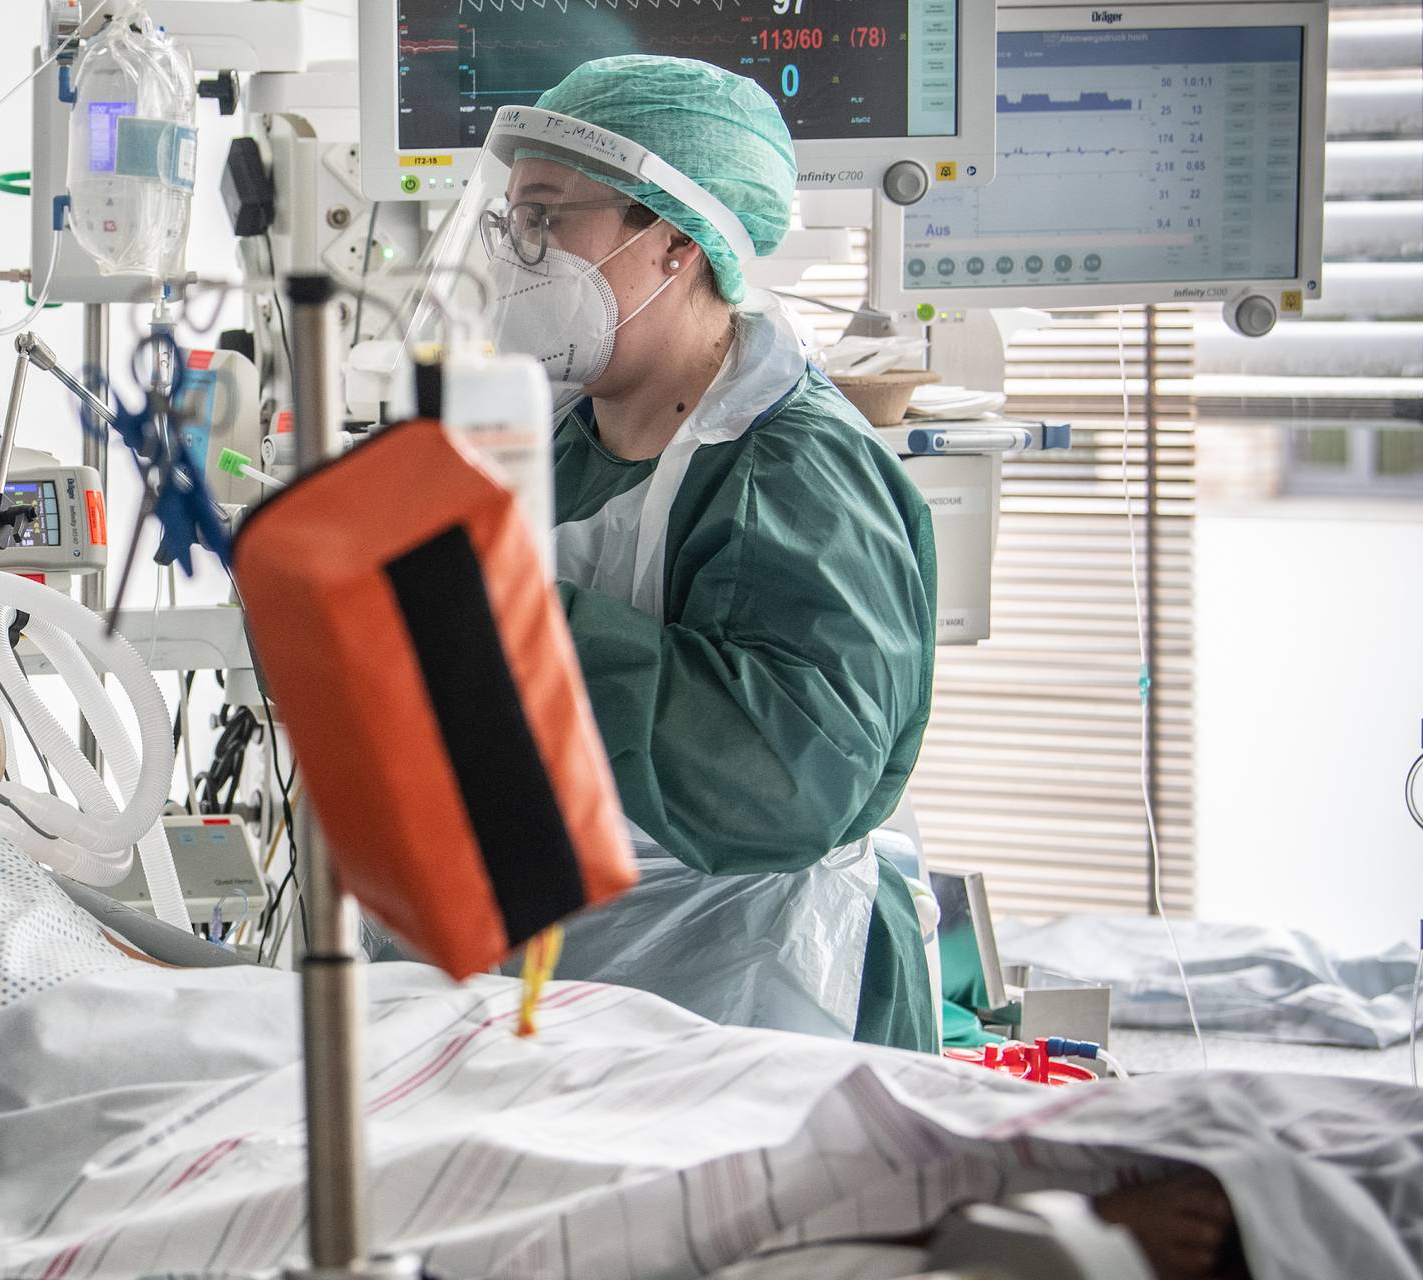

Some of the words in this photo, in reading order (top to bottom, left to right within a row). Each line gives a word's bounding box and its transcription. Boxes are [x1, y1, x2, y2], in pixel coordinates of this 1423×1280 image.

[1091, 11, 1123, 24] Dräger
[759, 28, 823, 50] 113/60
[850, 27, 886, 48] (78)
[781, 63, 800, 97] 0
[1161, 77, 1172, 87] 50
[1160, 105, 1171, 116] 25
[1192, 105, 1202, 115] 13
[1158, 133, 1174, 144] 174
[1189, 133, 1203, 144] 2,4
[797, 171, 836, 183] Infinity
[838, 170, 864, 181] C700
[1159, 190, 1169, 200] 31
[1189, 189, 1201, 199] 22
[925, 223, 951, 237] Aus
[1173, 288, 1206, 298] Infinity
